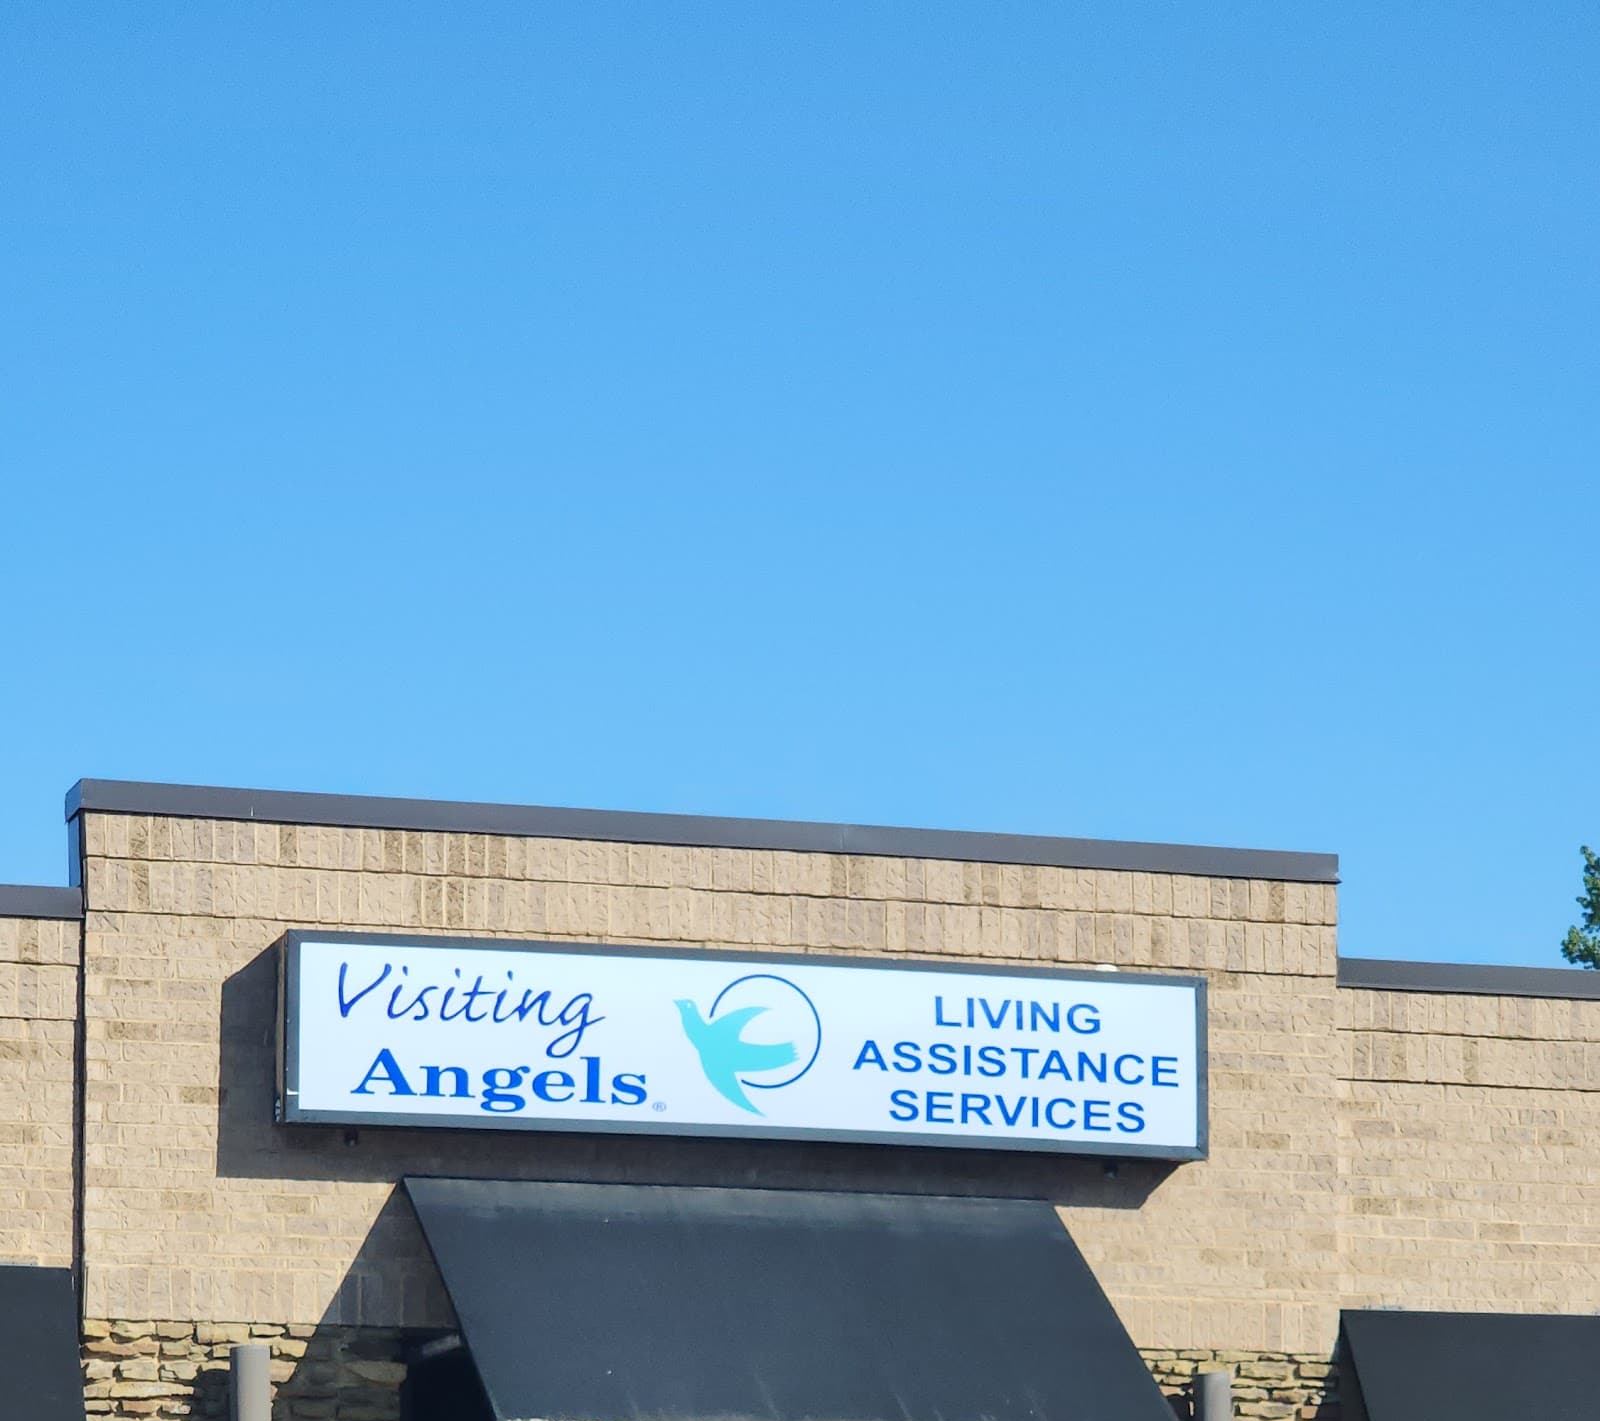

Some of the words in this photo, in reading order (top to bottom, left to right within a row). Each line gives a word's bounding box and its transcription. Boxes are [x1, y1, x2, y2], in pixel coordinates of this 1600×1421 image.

[338, 961, 605, 1058] Visiting
[934, 996, 1101, 1035] LIVING
[350, 1047, 648, 1113] Angels
[853, 1040, 1179, 1087] ASSISTANCE
[888, 1089, 1145, 1133] SERVICES
